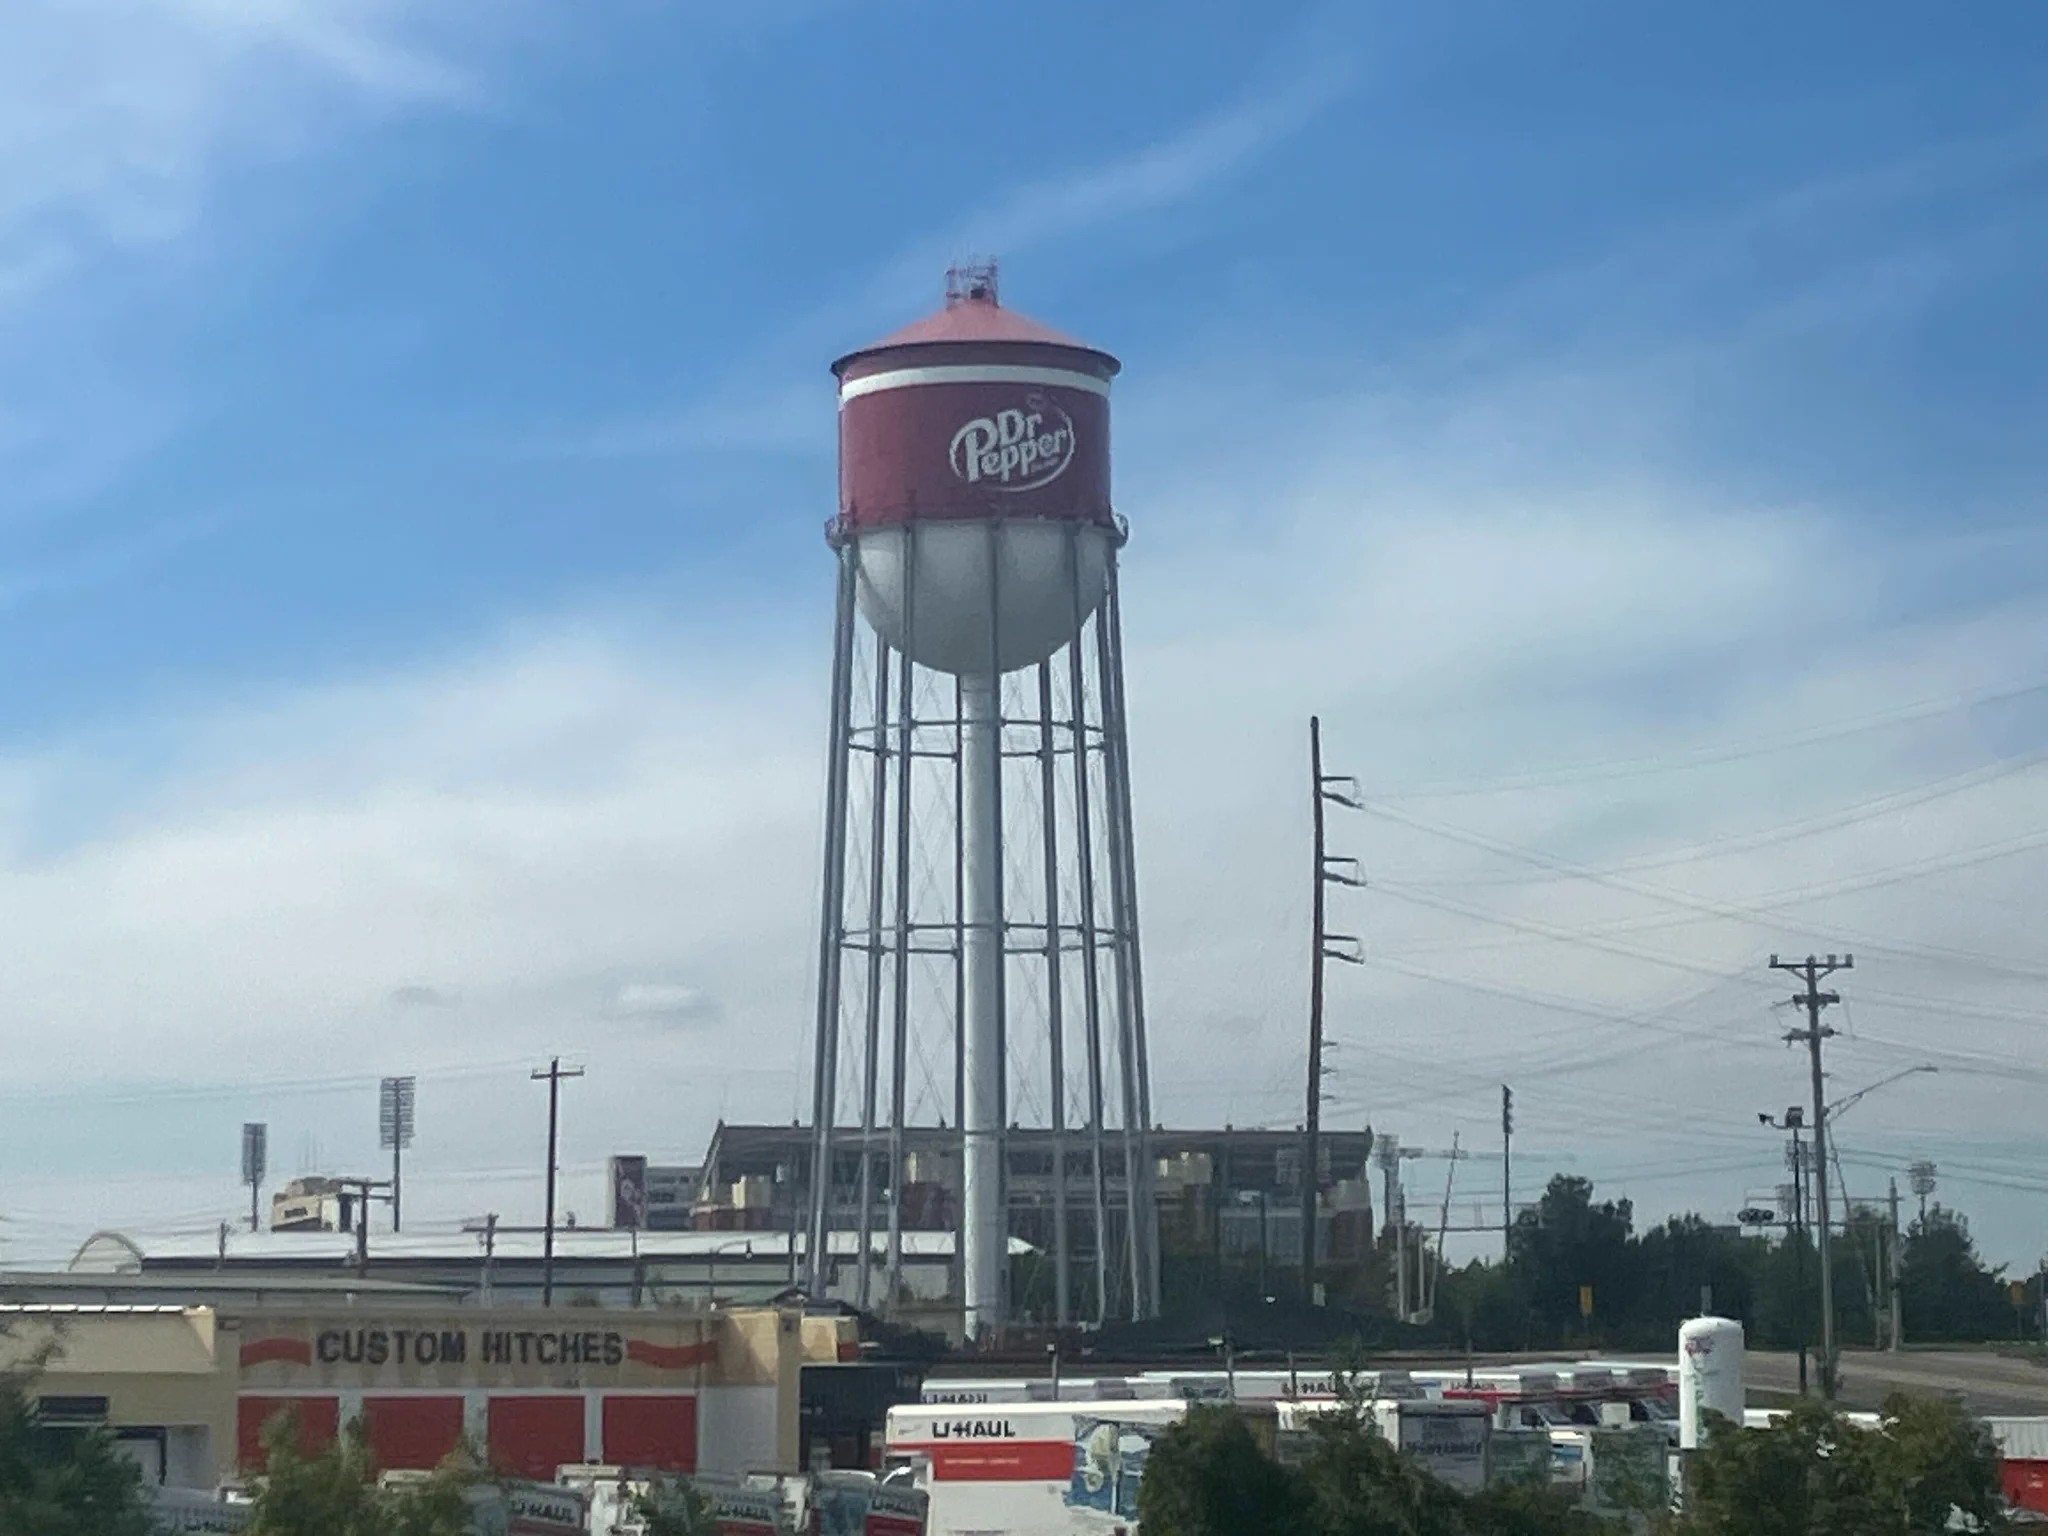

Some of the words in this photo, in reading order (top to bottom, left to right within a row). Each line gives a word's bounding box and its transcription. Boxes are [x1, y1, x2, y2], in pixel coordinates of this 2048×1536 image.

[997, 409, 1043, 447] Dr
[950, 417, 1068, 483] Pepper
[316, 1329, 466, 1365] CUSTOM
[482, 1331, 623, 1365] HITCHES
[932, 1420, 1016, 1438] U-HAUL
